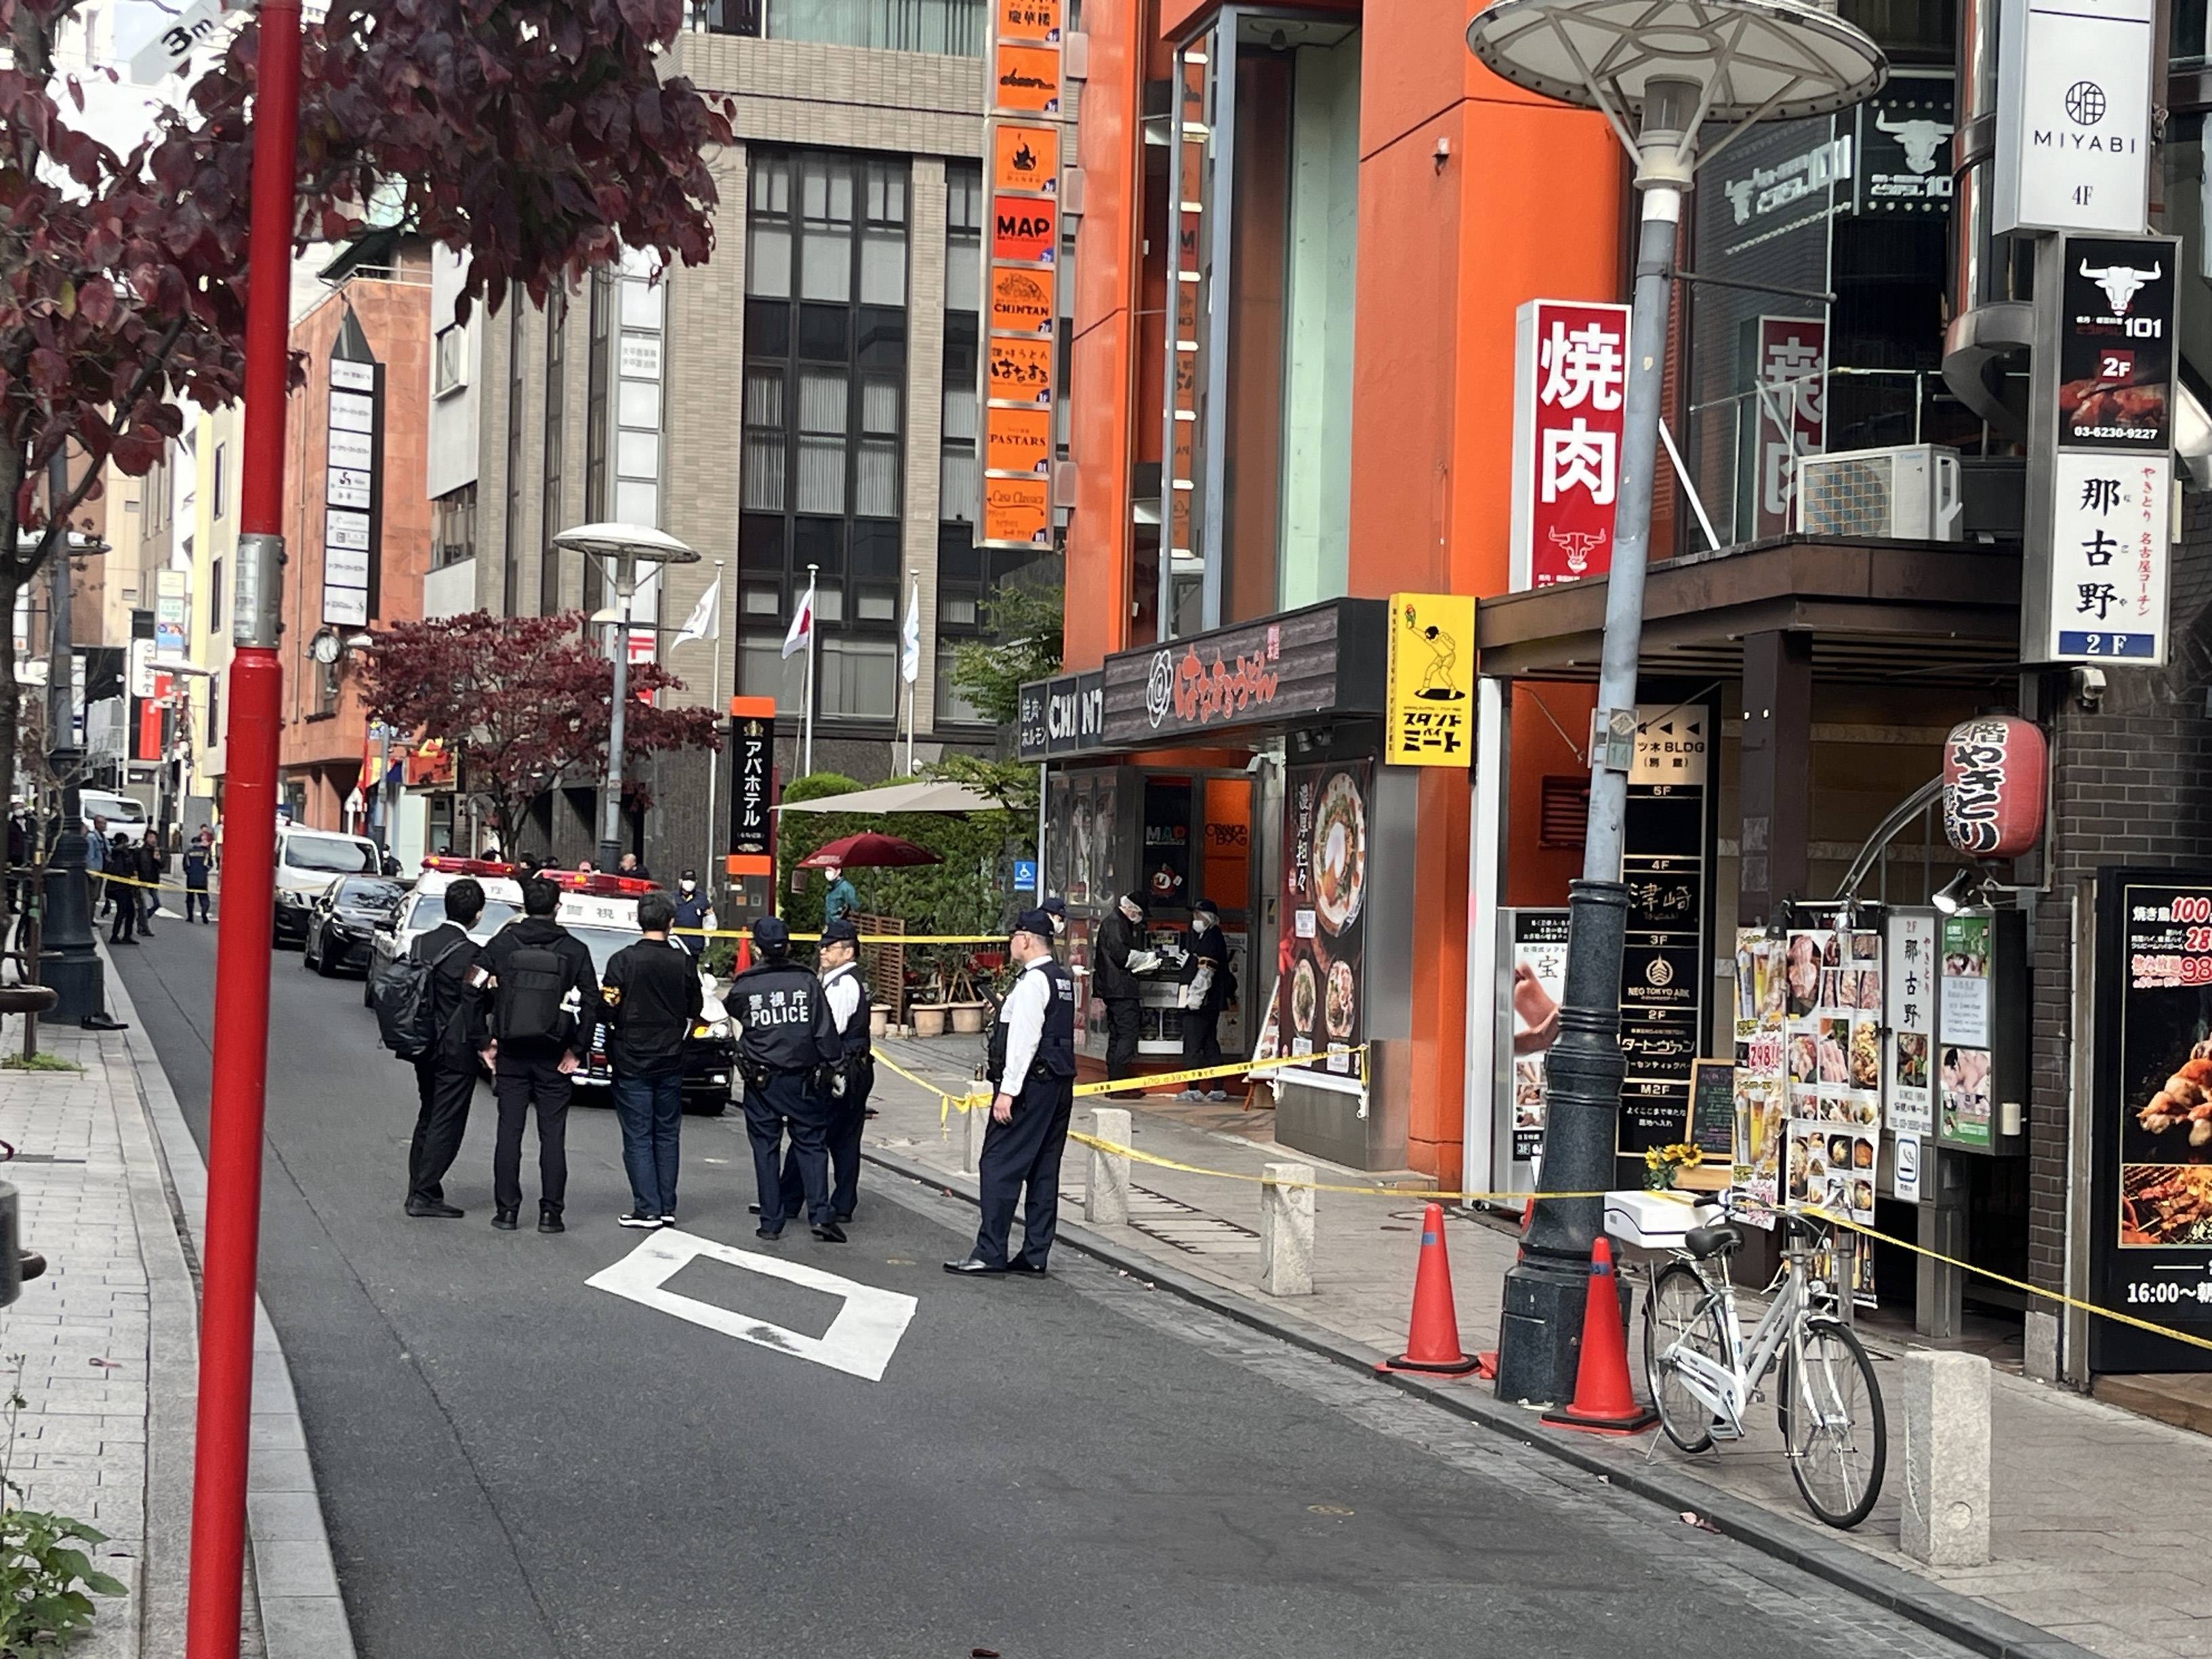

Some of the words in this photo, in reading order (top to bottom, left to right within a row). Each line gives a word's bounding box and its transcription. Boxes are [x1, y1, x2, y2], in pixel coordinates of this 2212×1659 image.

[2034, 129, 2135, 154] MIYABI
[2072, 186, 2093, 205] 4F
[998, 216, 1050, 238] MAP
[994, 303, 1049, 316] CHINTAN
[2125, 317, 2162, 338] 101
[2102, 357, 2131, 377] 2F
[1540, 321, 1623, 506] 焼肉
[989, 434, 1047, 447] PASTARS
[2140, 466, 2156, 522] やきとり
[2076, 477, 2122, 621] 那古野
[2137, 531, 2153, 617] 名古屋コーチン
[1403, 713, 1462, 727] スタンド
[1403, 731, 1461, 753] ミート
[1664, 741, 1704, 754] BLDG
[743, 741, 762, 827] アパホテル
[1952, 743, 2007, 853] やきとり
[2171, 896, 2211, 923] 100
[1650, 935, 1668, 945] 3F
[2184, 926, 2212, 952] 28
[1904, 939, 1921, 1029] 那古野
[749, 989, 807, 1010] 警視庁
[750, 1006, 808, 1027] POLICE
[1648, 1010, 1666, 1020] 2F
[1641, 1084, 1670, 1094] M2F
